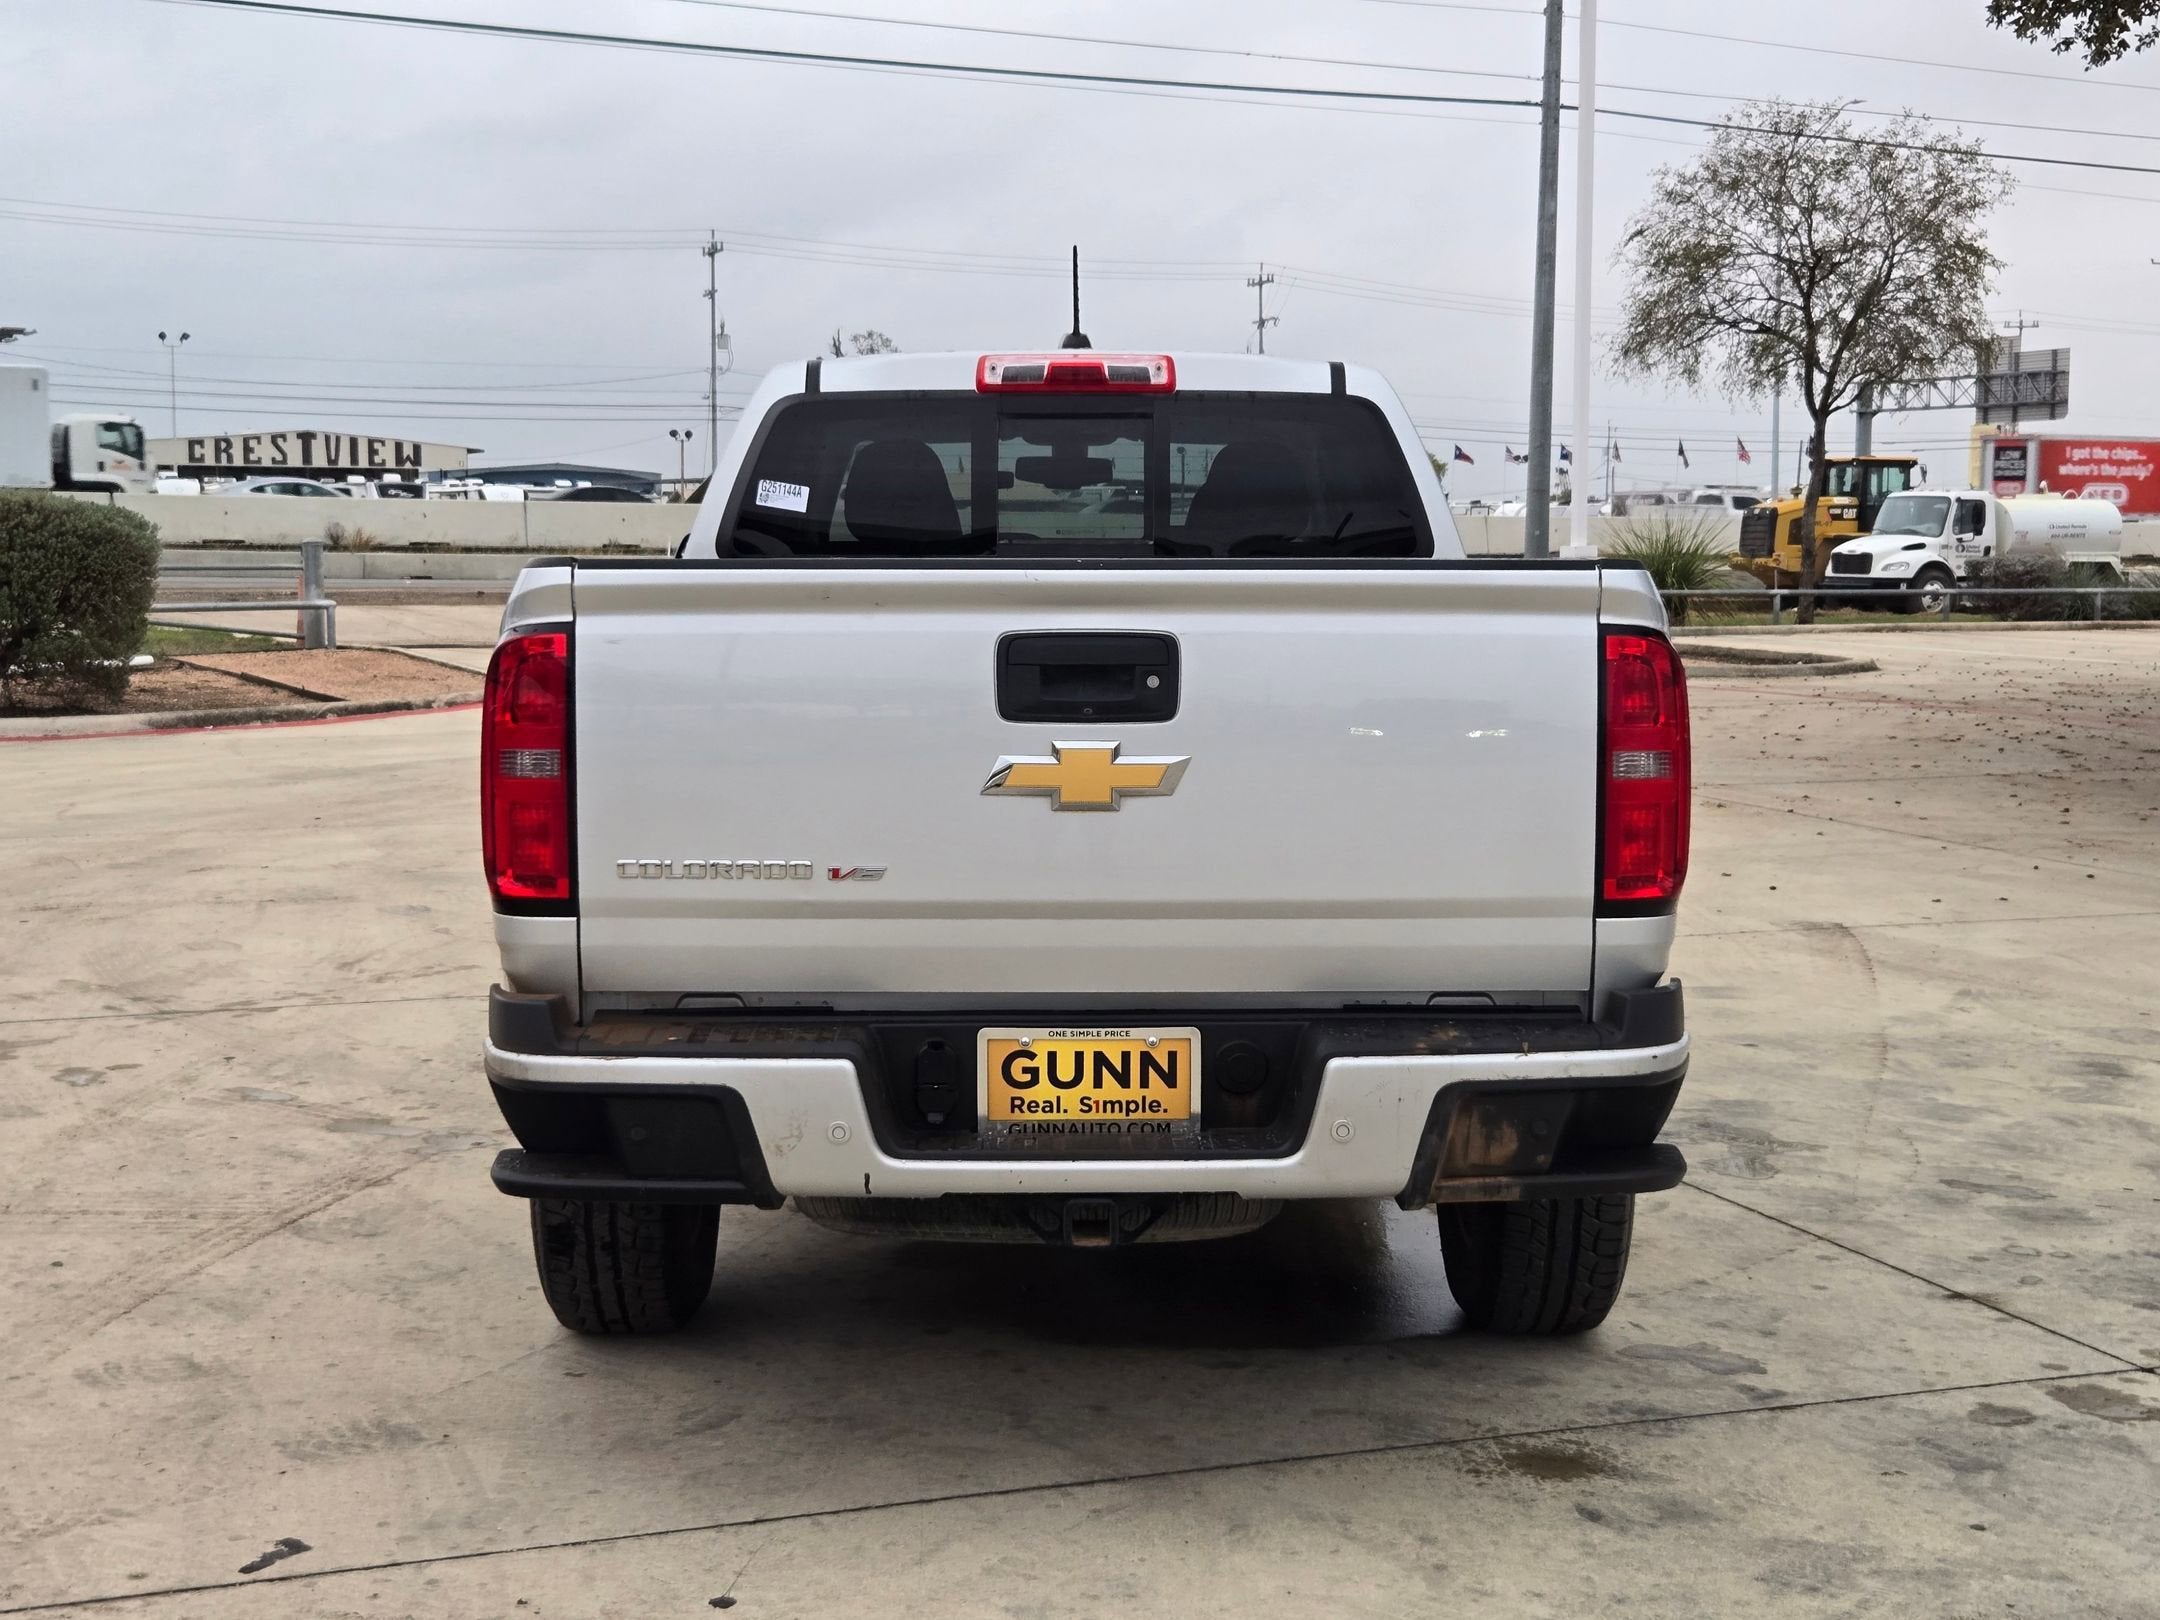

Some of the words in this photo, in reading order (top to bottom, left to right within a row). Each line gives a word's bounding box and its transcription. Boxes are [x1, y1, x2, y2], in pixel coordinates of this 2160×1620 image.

[188, 431, 422, 467] CRESTVIEW
[1999, 450, 2022, 460] LOW
[2072, 447, 2091, 461] got
[2092, 446, 2110, 459] the
[2058, 462, 2099, 476] where's
[2100, 462, 2117, 476] the
[761, 480, 802, 498] G251144A
[1843, 508, 1858, 519] CAT
[616, 858, 814, 880] COLORADO
[827, 864, 888, 882] V6
[1048, 1030, 1068, 1038] ONE
[1070, 1030, 1102, 1038] SIMPLE
[1104, 1030, 1131, 1038] PRICE
[1001, 1049, 1178, 1090] GUNN
[1010, 1095, 1069, 1114] Real.
